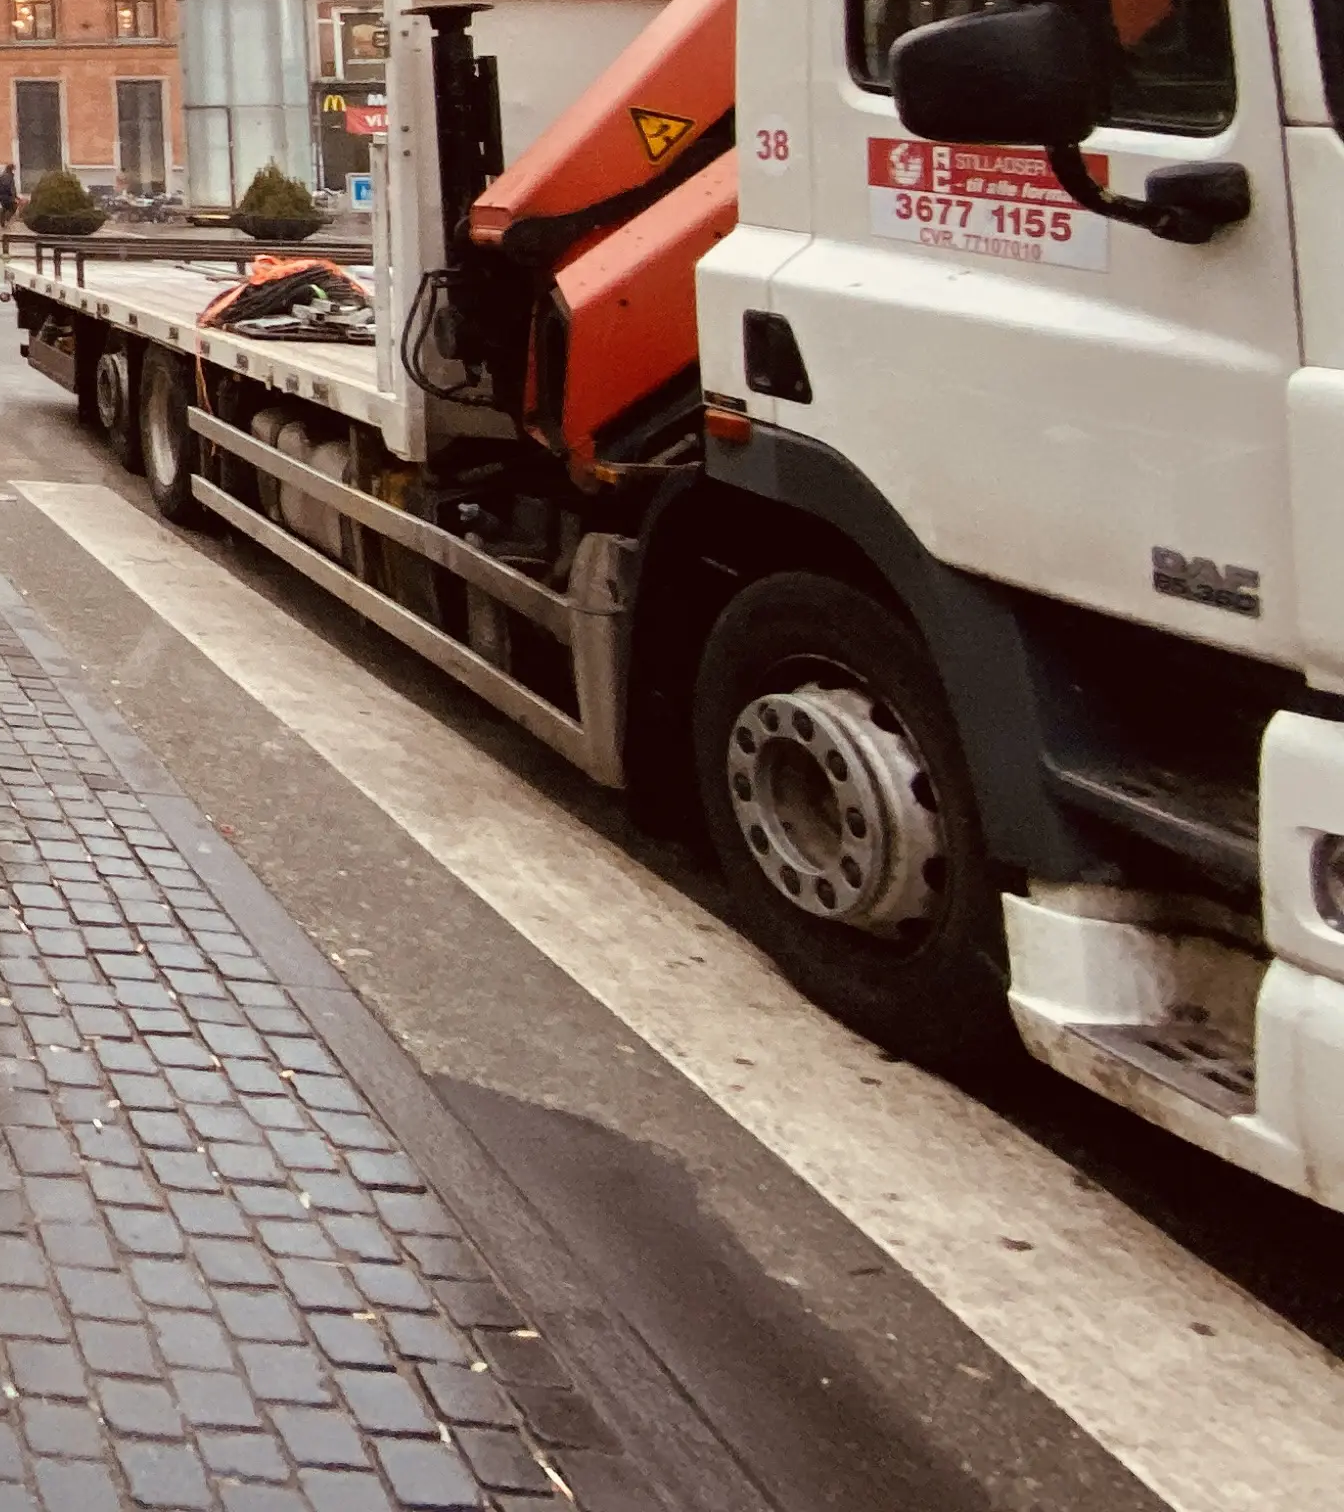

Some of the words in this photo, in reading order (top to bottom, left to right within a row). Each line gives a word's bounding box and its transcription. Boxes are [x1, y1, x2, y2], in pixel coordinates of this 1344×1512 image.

[757, 129, 789, 161] 38
[896, 193, 973, 229] 3677
[992, 205, 1072, 241] 1155
[1152, 546, 1260, 590] DAF
